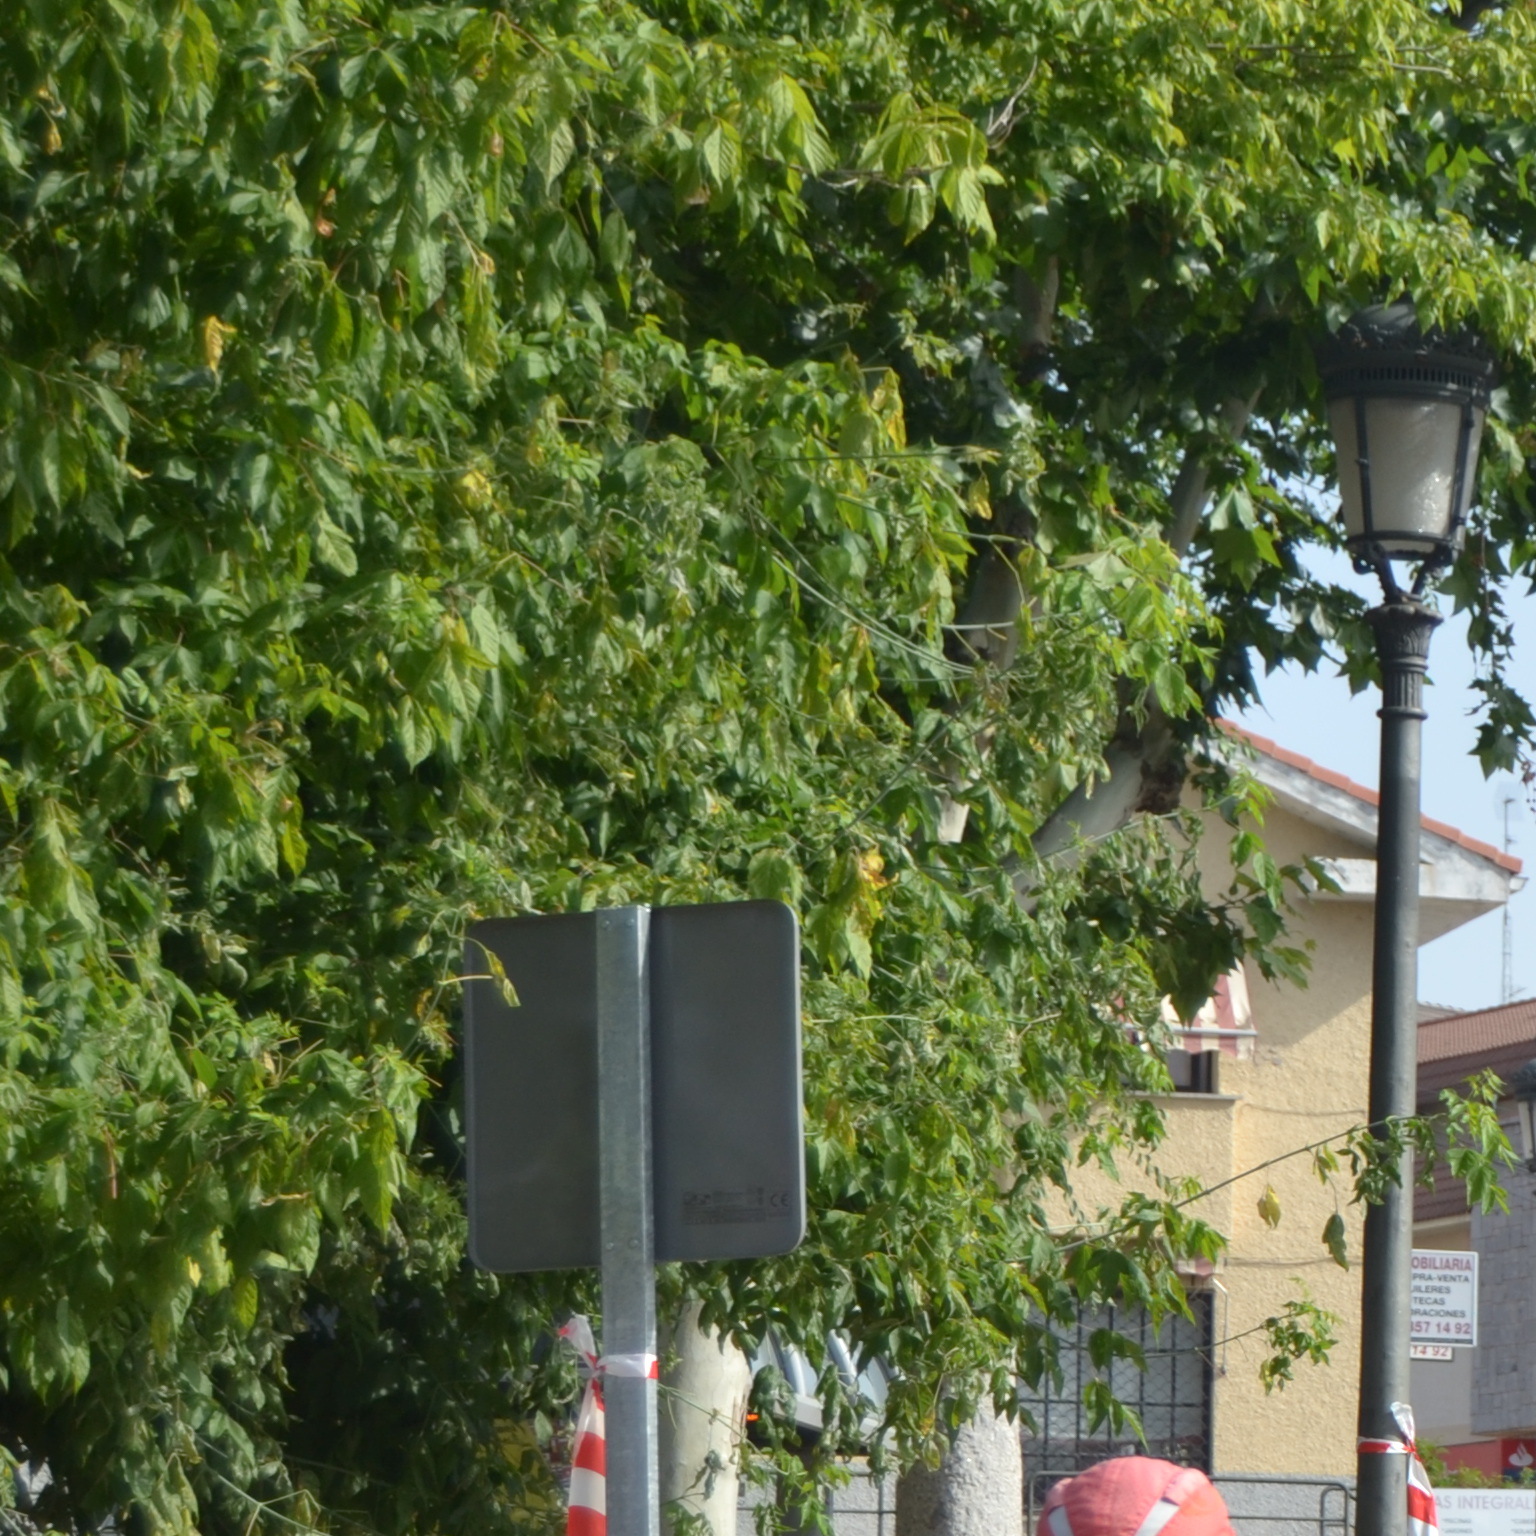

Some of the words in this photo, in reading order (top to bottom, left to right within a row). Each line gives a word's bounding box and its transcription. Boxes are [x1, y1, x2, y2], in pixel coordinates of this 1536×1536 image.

[1411, 1256, 1472, 1271] OBILIARIA
[1412, 1272, 1470, 1283] PRA-VENTA
[1413, 1296, 1446, 1306] TECAS
[1435, 1322, 1451, 1334] 14
[1454, 1322, 1472, 1335] 92
[1431, 1346, 1449, 1357] 92
[1457, 1495, 1535, 1510] INTEGRAL
